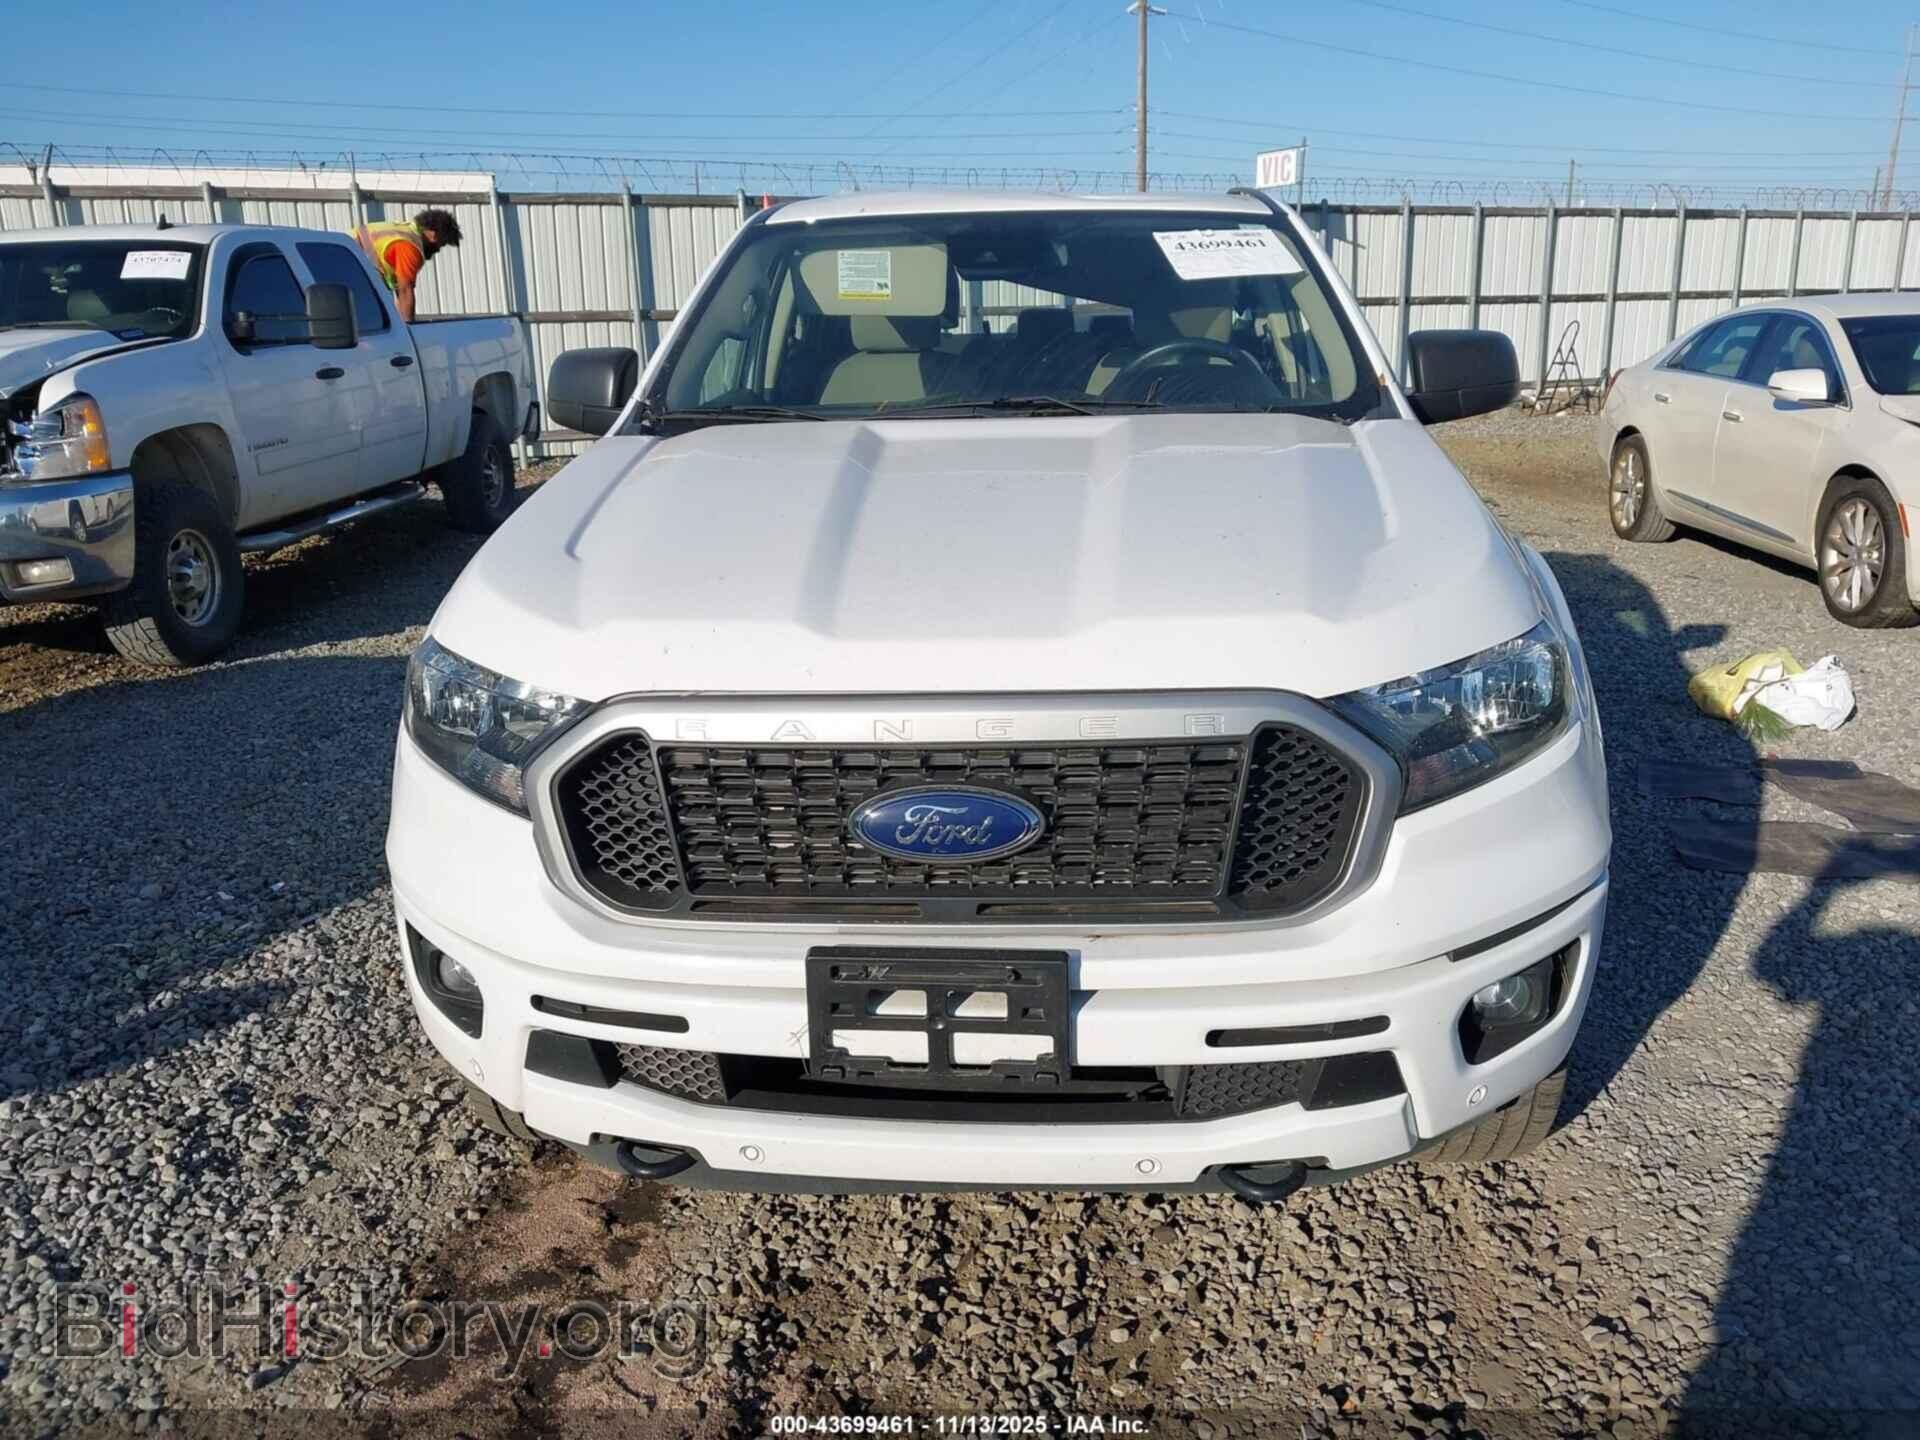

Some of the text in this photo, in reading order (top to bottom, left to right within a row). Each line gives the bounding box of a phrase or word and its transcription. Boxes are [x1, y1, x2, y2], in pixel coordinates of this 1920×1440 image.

[1262, 153, 1292, 185] VIC
[1174, 238, 1268, 252] 43699461
[675, 713, 1225, 741] RANGER
[895, 804, 994, 845] Ford
